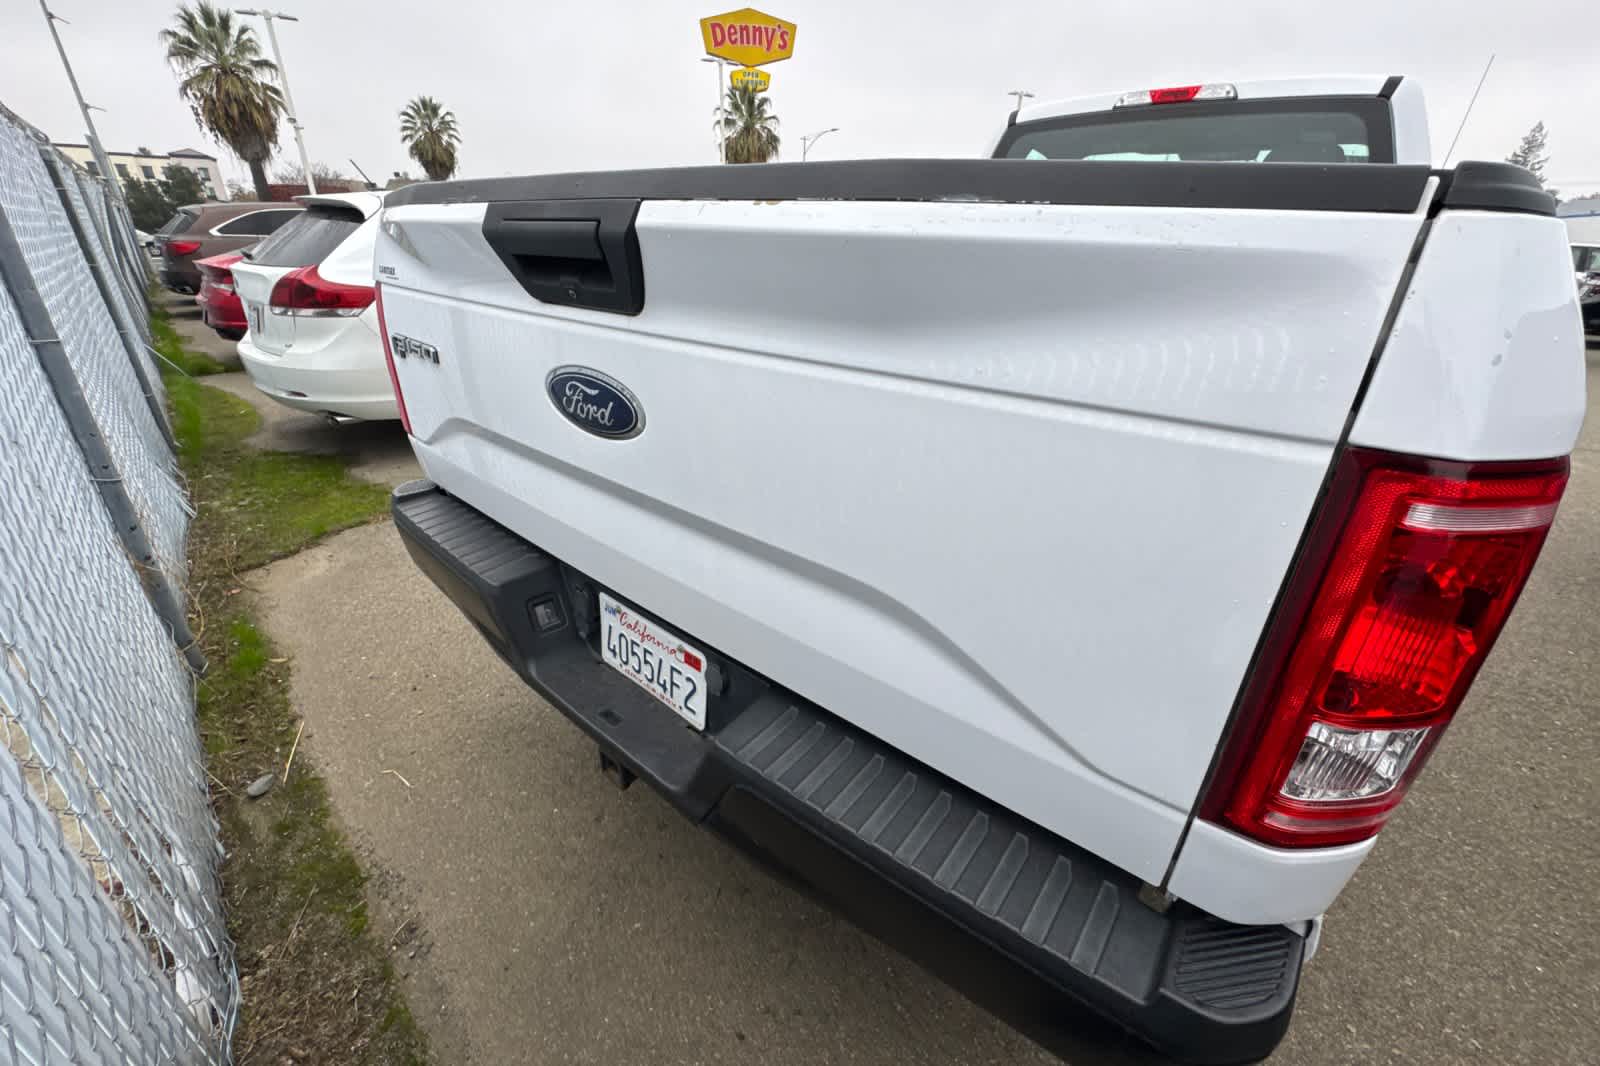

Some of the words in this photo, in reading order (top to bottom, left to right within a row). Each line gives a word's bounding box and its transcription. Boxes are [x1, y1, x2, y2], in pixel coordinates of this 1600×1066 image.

[710, 22, 789, 51] Denny's
[563, 381, 614, 426] Ford
[619, 611, 678, 656] California
[607, 624, 697, 715] 40554F2
